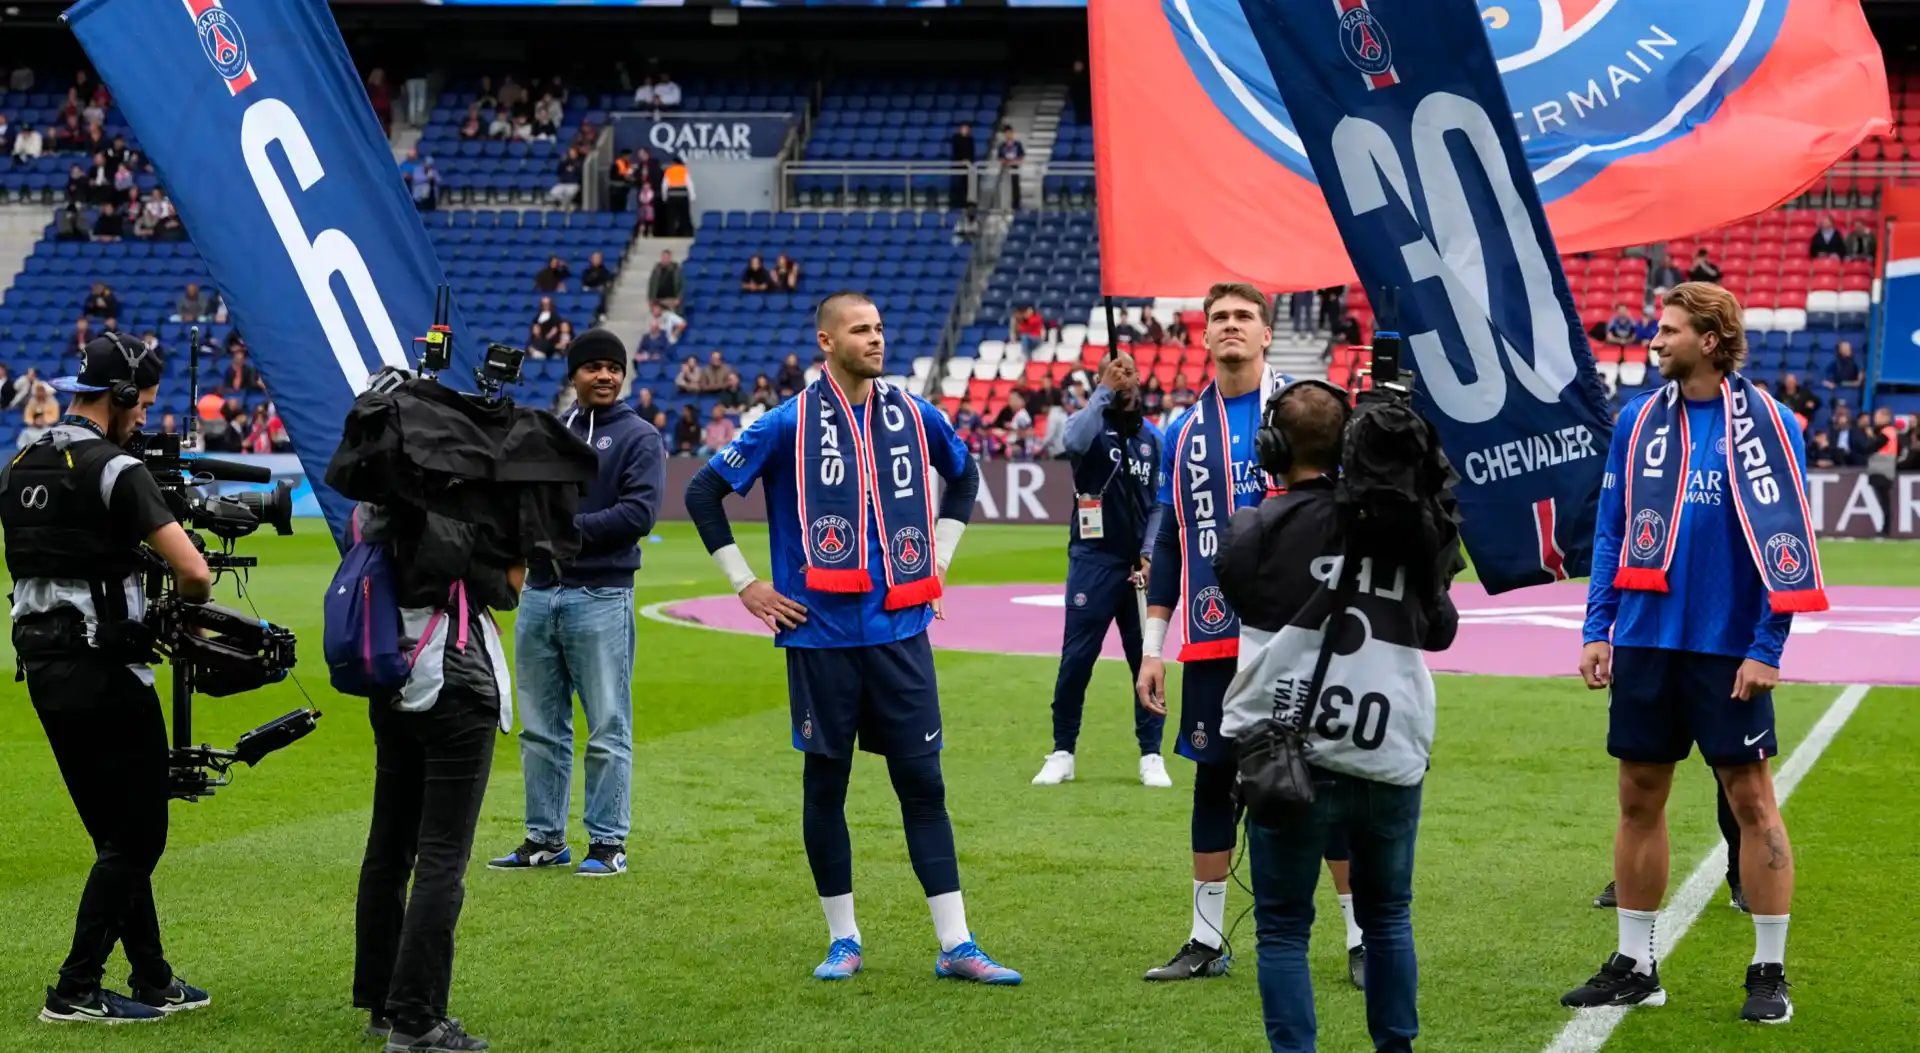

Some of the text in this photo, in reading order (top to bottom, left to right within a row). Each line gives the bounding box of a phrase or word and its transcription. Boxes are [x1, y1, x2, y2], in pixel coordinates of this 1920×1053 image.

[200, 12, 226, 36] PARIS
[1343, 11, 1373, 32] PARIS
[1513, 24, 1678, 142] RMAIN
[649, 122, 752, 154] QATAR
[820, 392, 845, 486] ARIS
[1465, 424, 1598, 485] CHEVALIER
[1187, 435, 1218, 557] PARIS
[1684, 491, 1721, 506] WAYS
[1805, 473, 1920, 533] TAR
[816, 517, 847, 530] PARIS
[1637, 510, 1660, 525] PARIS
[896, 528, 919, 542] PARIS
[1769, 535, 1798, 549] PARIS
[1199, 588, 1225, 601] PARIS
